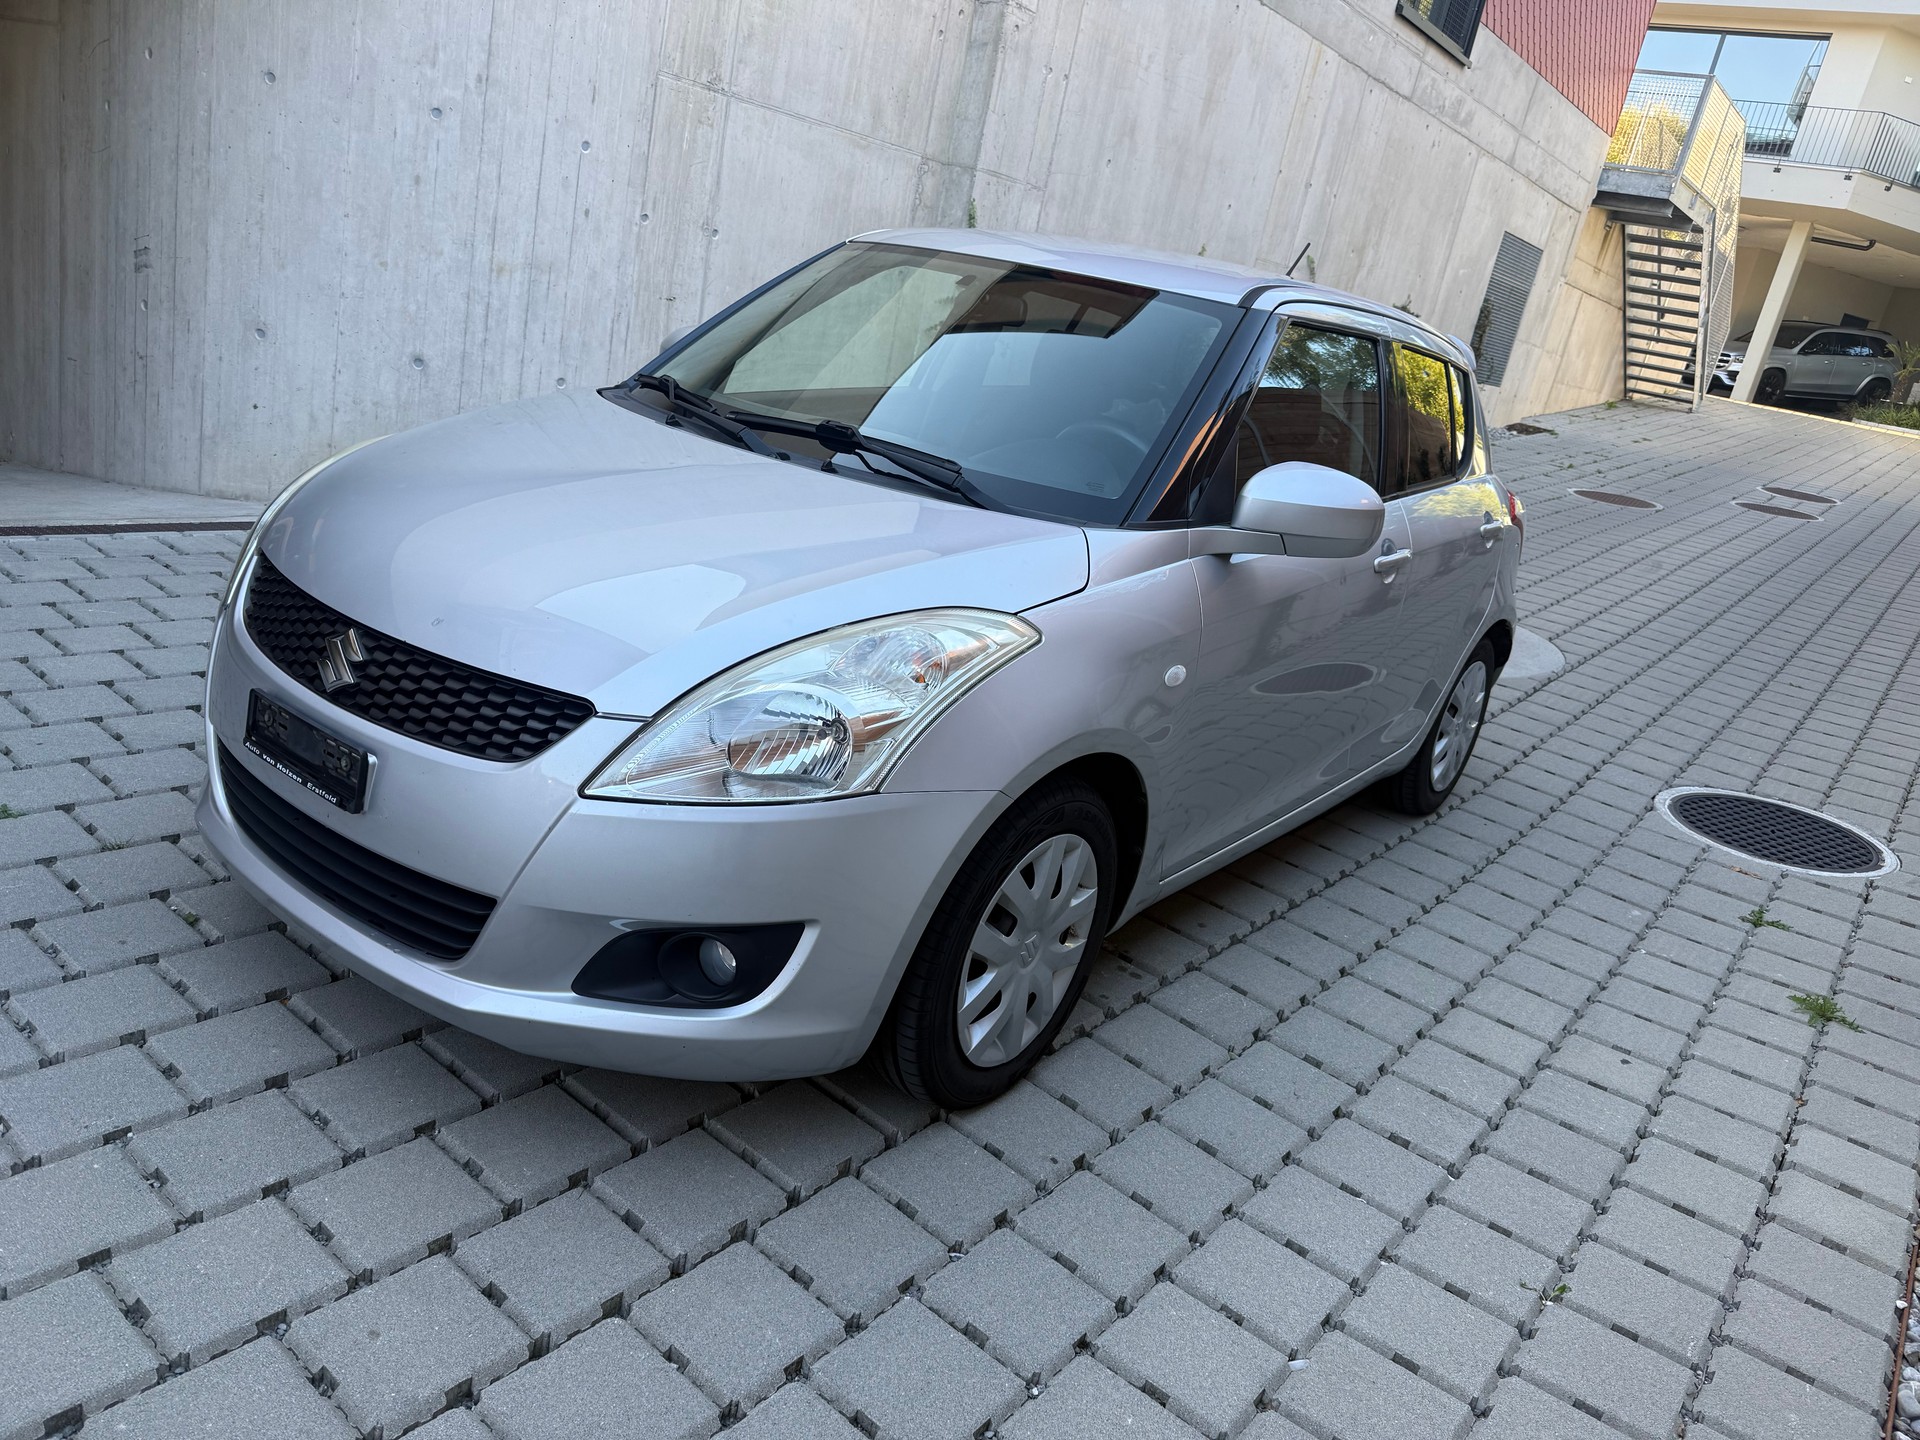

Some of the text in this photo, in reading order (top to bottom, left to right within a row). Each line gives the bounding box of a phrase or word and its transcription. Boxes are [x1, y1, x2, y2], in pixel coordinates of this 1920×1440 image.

[245, 741, 337, 804] Auto von Holzen Erstfeld
